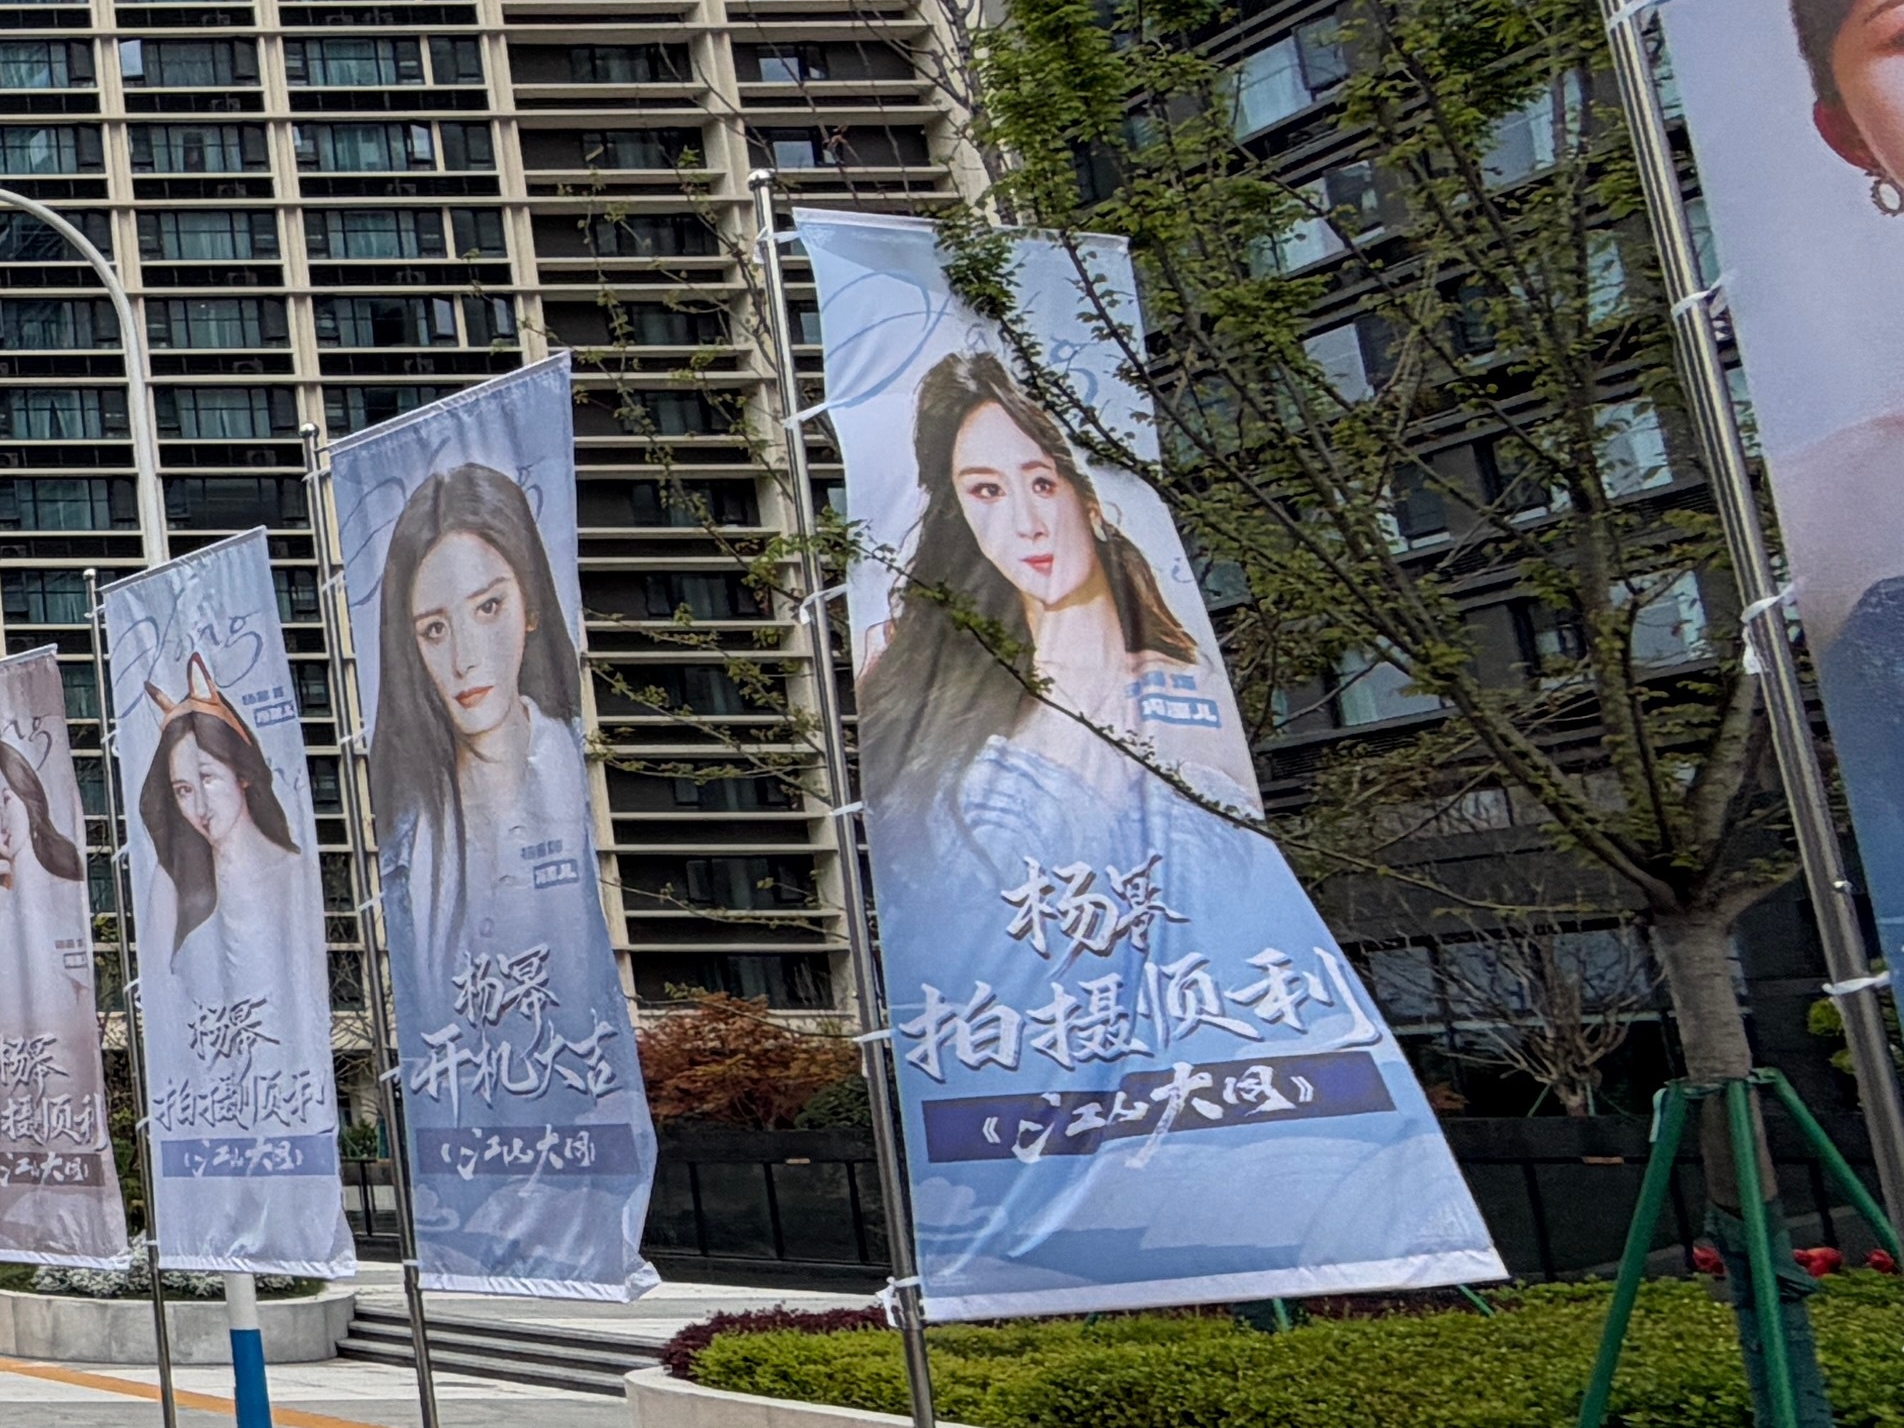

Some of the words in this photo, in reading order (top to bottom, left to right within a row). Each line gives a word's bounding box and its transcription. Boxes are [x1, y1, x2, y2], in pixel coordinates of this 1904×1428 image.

[1001, 854, 1192, 976] 杨幂
[187, 994, 281, 1077] 杨幂
[451, 943, 561, 1052] 杨幂
[898, 946, 1383, 1084] 拍摄顺利
[152, 1069, 336, 1135] 拍摄顺利
[410, 1007, 623, 1128] 开机大吉
[982, 1061, 1315, 1169] 《江山大同》
